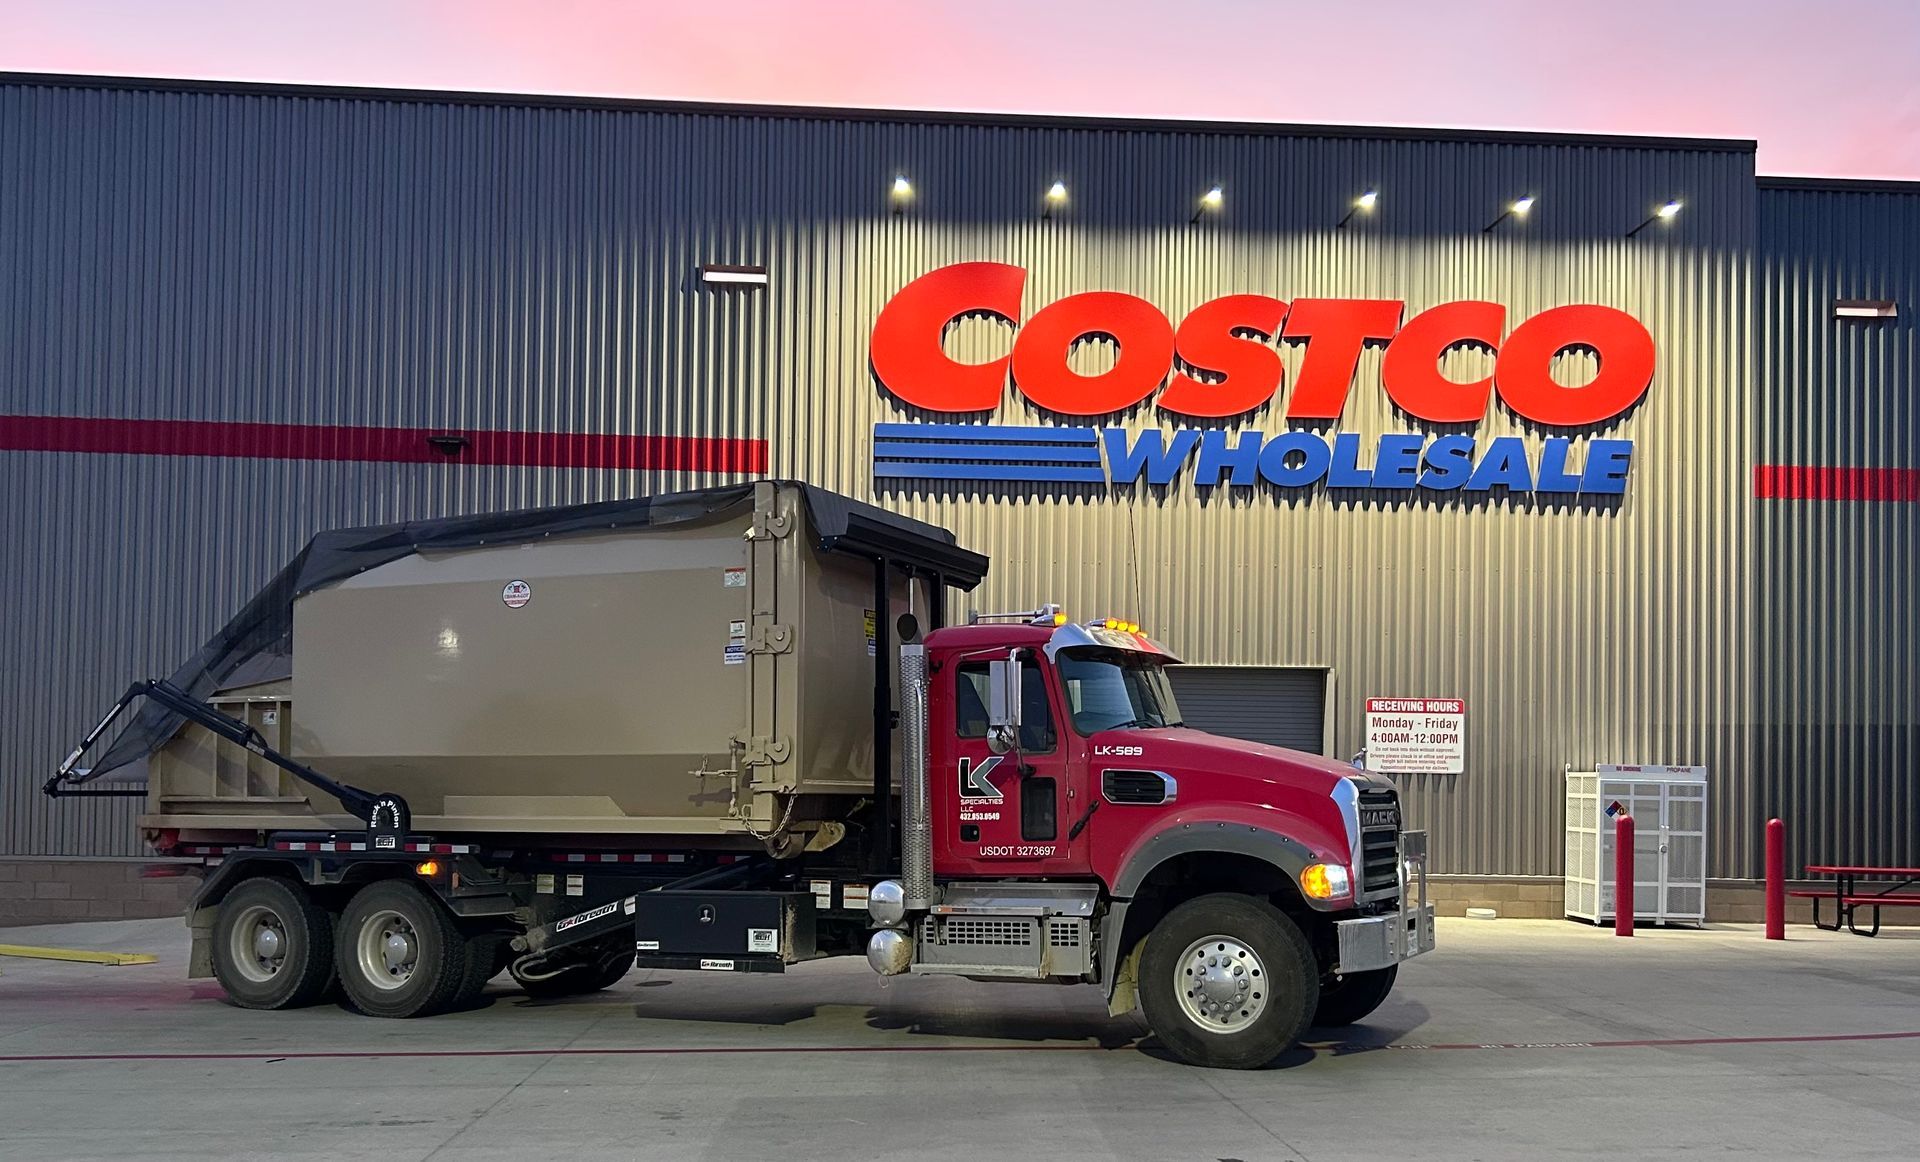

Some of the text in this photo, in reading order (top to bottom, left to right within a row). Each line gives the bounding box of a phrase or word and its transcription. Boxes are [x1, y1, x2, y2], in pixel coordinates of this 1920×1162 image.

[871, 261, 1656, 426] COSTCO
[1102, 428, 1635, 494] WHOLESALE
[1371, 700, 1459, 713] RECEIVING HOURS
[1372, 717, 1414, 731] Monday
[1425, 718, 1458, 731] Friday
[1371, 733, 1458, 744] 4:00AM-12:00PM
[1094, 745, 1143, 756] LK-589
[960, 798, 1004, 806] SPECIALTIES
[370, 804, 380, 828] Rack
[387, 800, 400, 828] Pinion
[1362, 810, 1396, 825] MACK
[979, 845, 1056, 856] USDOT 3273697
